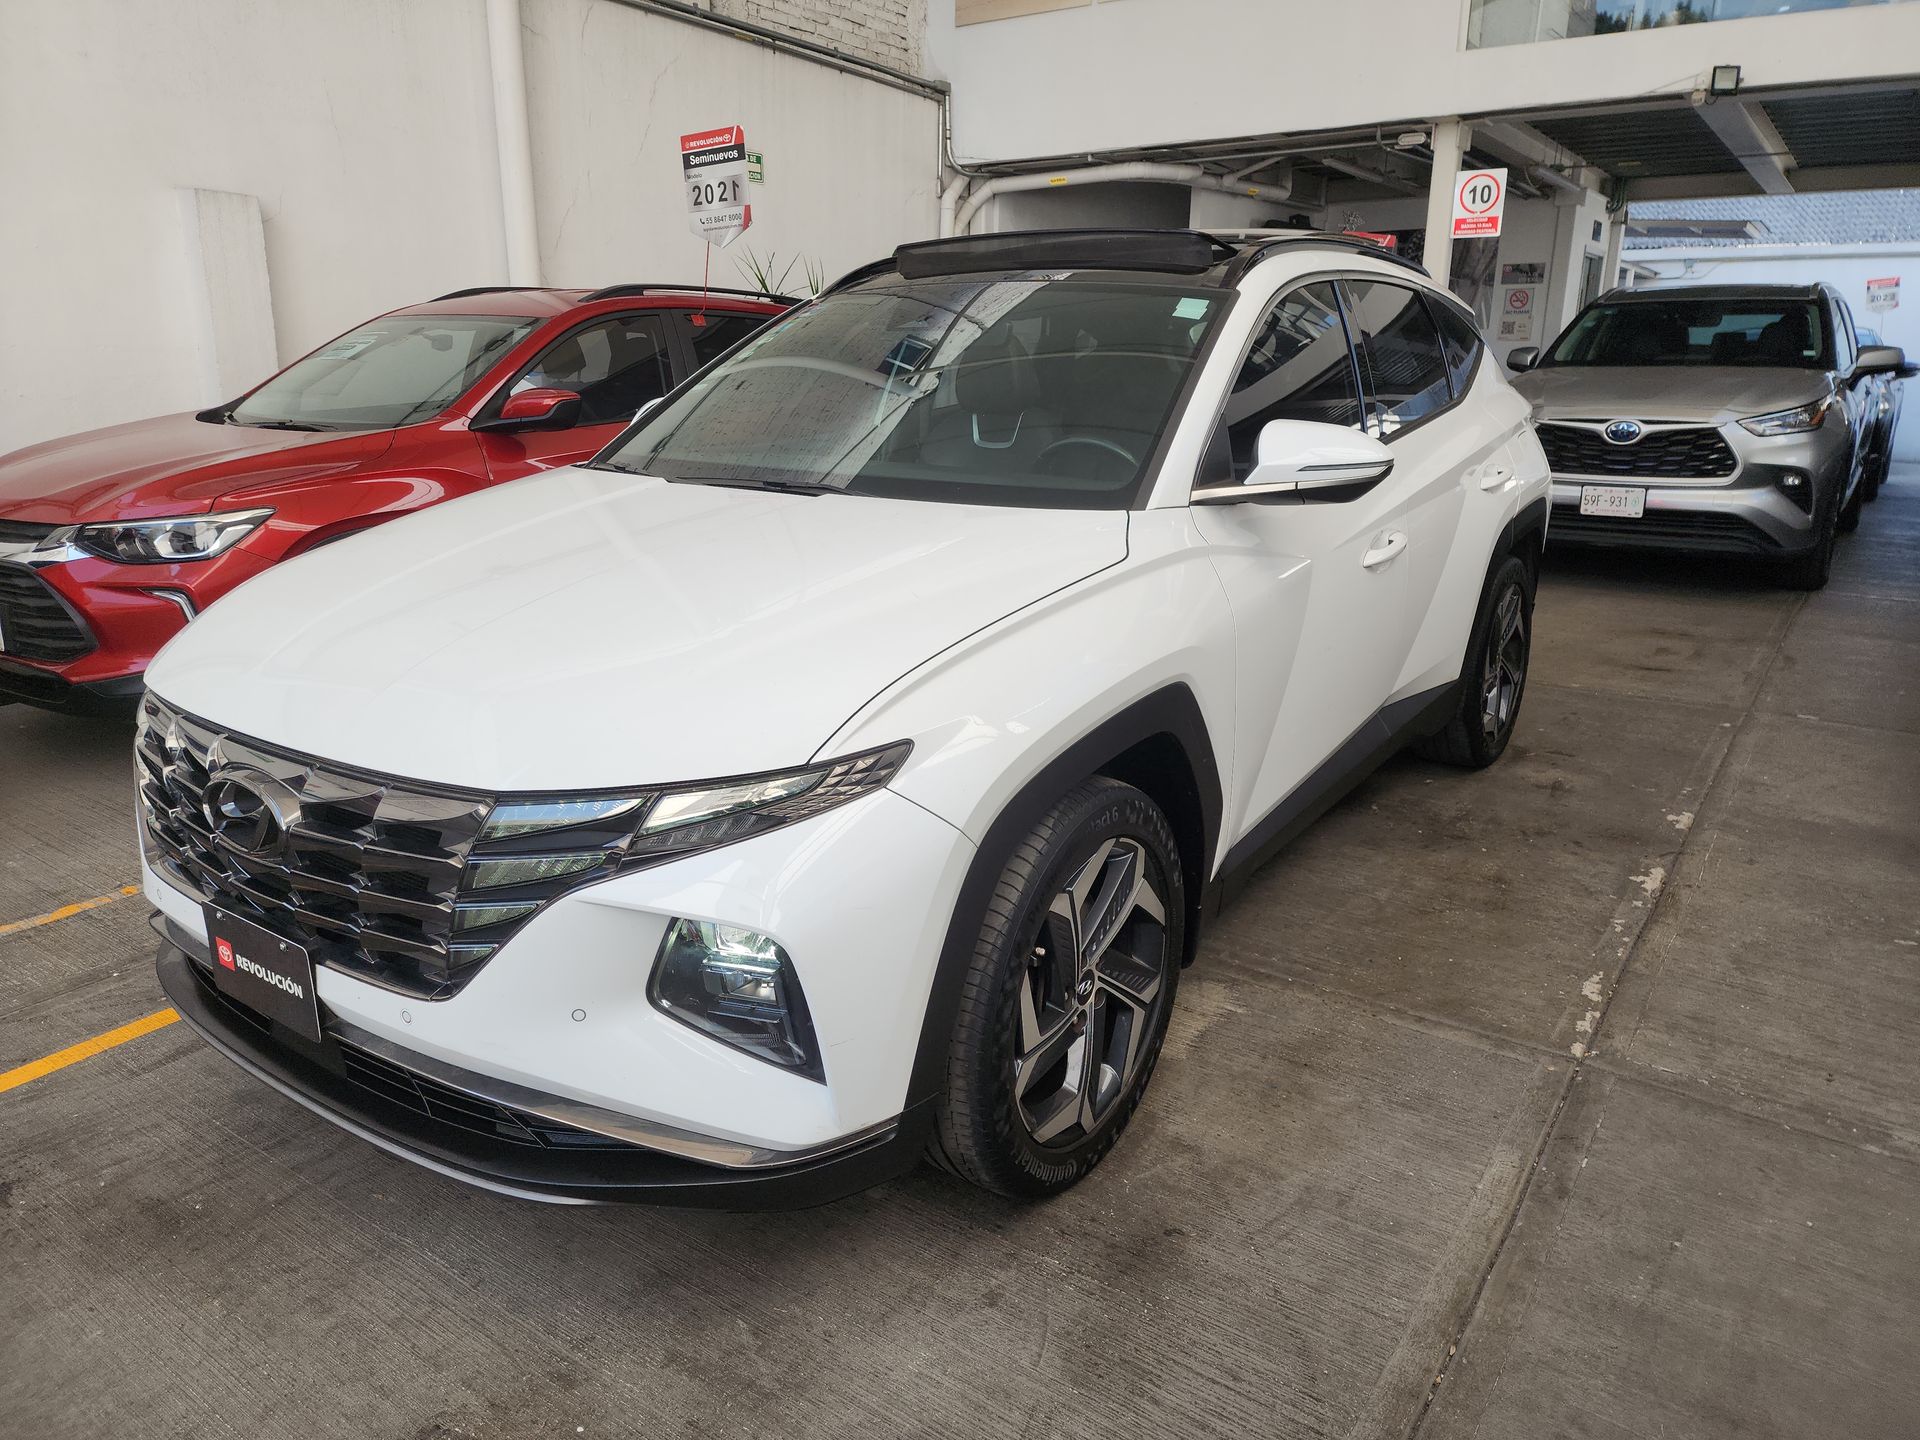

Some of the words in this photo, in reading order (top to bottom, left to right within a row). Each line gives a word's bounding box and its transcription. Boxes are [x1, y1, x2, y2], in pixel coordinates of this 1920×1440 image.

[689, 136, 723, 147] REVOLUCIÓN
[689, 149, 739, 166] Seminuevos
[692, 181, 740, 206] 2021
[1468, 184, 1492, 205] 10
[1583, 494, 1628, 508] 59F-931
[235, 953, 304, 999] REVOLUCIÓN
